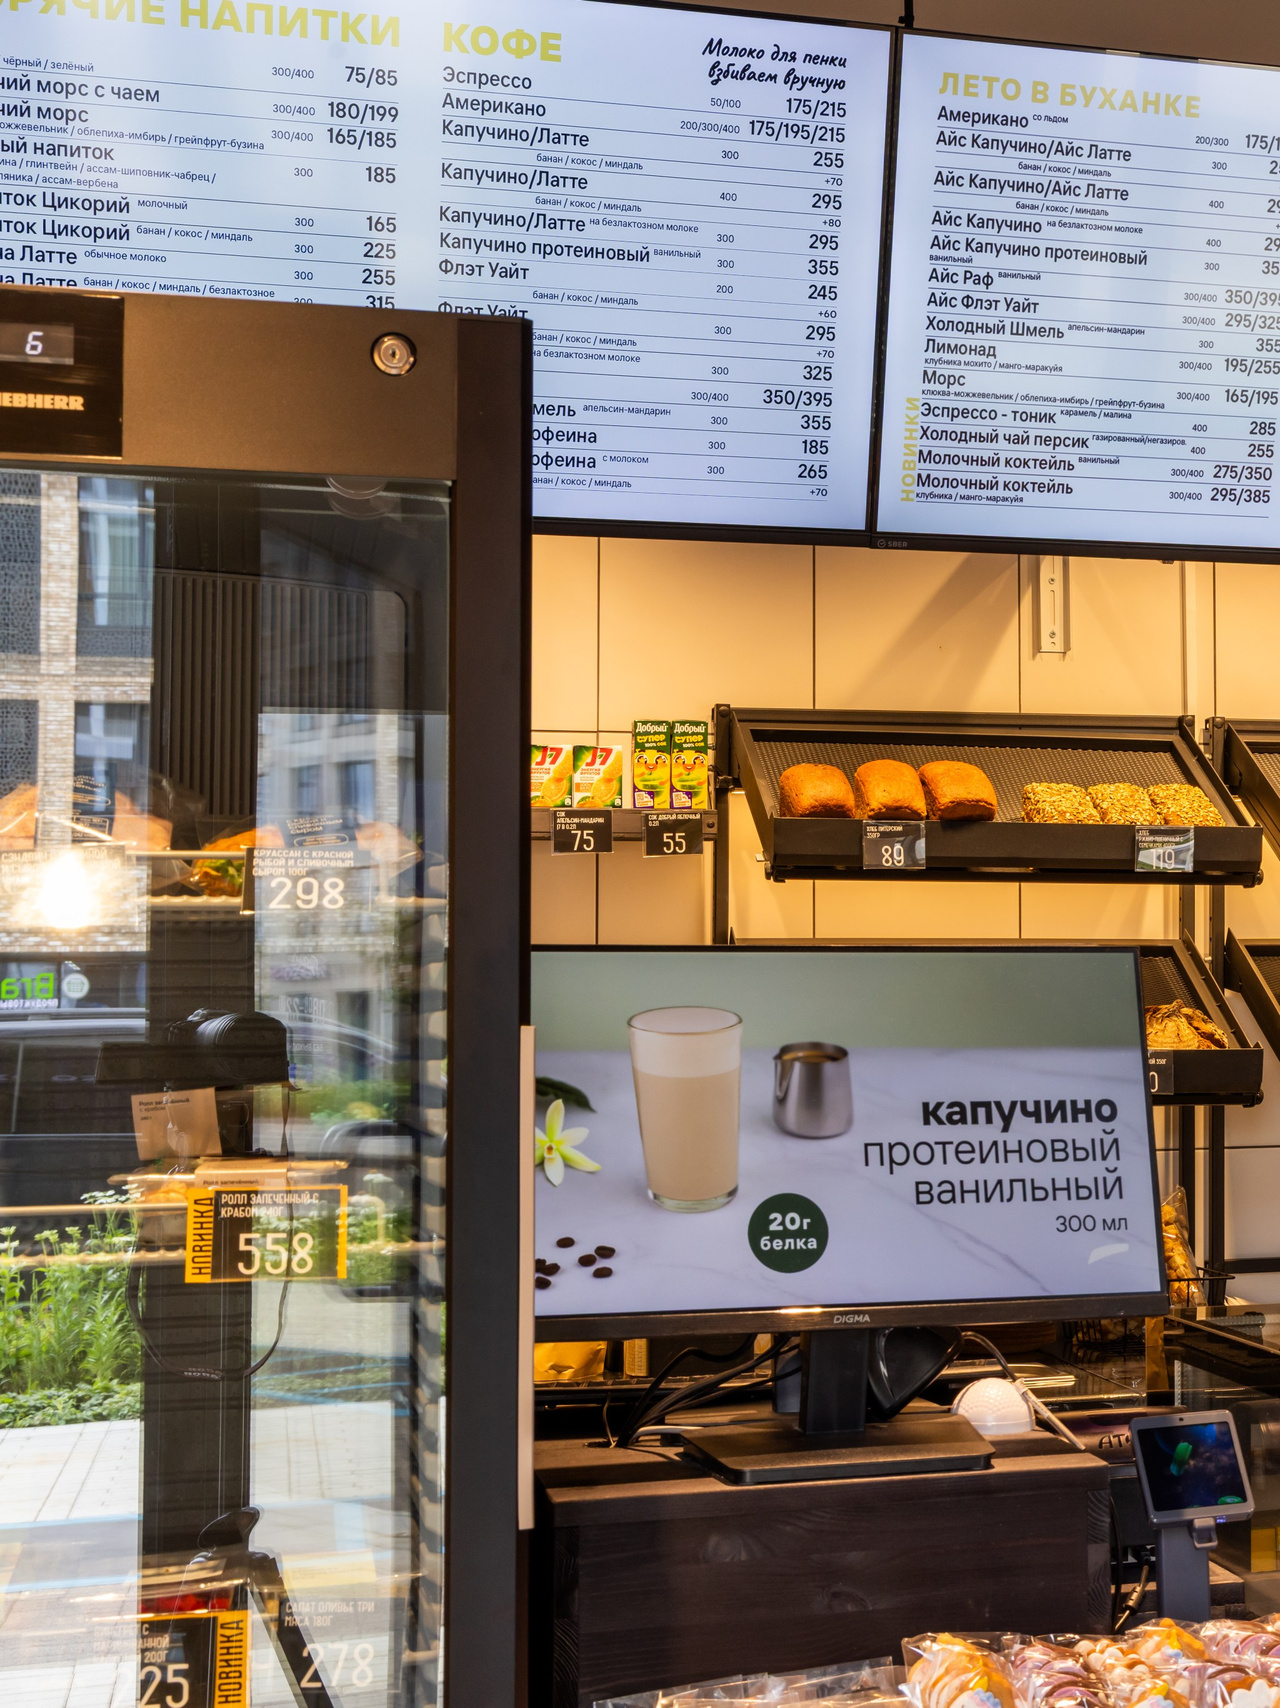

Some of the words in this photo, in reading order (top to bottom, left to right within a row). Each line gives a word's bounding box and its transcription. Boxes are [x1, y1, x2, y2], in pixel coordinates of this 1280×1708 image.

[180, 0, 399, 47] НАПИТКИ
[444, 22, 562, 62] КОФЕ
[701, 37, 765, 60] Молоко
[770, 43, 797, 63] для
[802, 53, 847, 69] пенки
[443, 66, 532, 90] Эспрессо
[710, 97, 742, 110] 50/100
[786, 97, 847, 120] 175/215
[708, 60, 778, 86] взбиваем
[783, 67, 846, 94] вручную
[938, 71, 1021, 101] ЛЕТО
[1031, 80, 1049, 104] В
[1059, 83, 1200, 118] БУХАНКЕ
[441, 92, 546, 119] Американо
[680, 120, 741, 135] 200/300/400
[747, 119, 846, 145] 175/195/215
[937, 105, 1029, 130] Американо
[1032, 113, 1043, 122] со
[1043, 114, 1069, 124] льдом
[1195, 135, 1230, 147] 200/300
[42, 191, 130, 216] Цикорий
[137, 199, 188, 210] молочный
[294, 217, 315, 228] 300
[366, 215, 397, 233] 165
[440, 232, 527, 255] Капучино
[532, 242, 650, 263] протеиновый
[653, 248, 702, 259] ванильный
[716, 259, 735, 269] 300
[807, 258, 839, 276] 355
[25, 331, 44, 355] 6
[0, 391, 84, 411] EBHERR
[900, 397, 920, 502] НОВИНКИ
[918, 449, 1001, 468] Молочный
[1004, 455, 1075, 471] коктейль
[1078, 456, 1120, 465] ванильный
[1170, 468, 1205, 479] 300/400
[1212, 464, 1273, 483] 275/350
[887, 540, 908, 548] SBER
[636, 723, 668, 733] Добрый
[674, 723, 706, 733] Добрый
[535, 747, 563, 766] J7
[585, 747, 613, 767] J7
[254, 849, 300, 857] КРУАССАН
[312, 850, 354, 858] КРАСНОЙ
[571, 830, 594, 850] 75
[663, 833, 686, 853] 55
[882, 845, 904, 866] 89
[252, 867, 285, 876] СЫРОМ
[288, 868, 308, 876] 100Г
[253, 857, 285, 866] РЫБОЙ
[288, 858, 294, 866] И
[297, 859, 354, 867] СЛИВОЧНЫМ
[1150, 849, 1175, 869] 119
[269, 877, 345, 909] 298
[922, 1098, 1118, 1135] капучино
[864, 1128, 1120, 1175] протеиновый
[222, 1194, 248, 1204] РОЛЛ
[250, 1192, 310, 1204] ЗАПЕЧЕННЫЙ
[313, 1193, 319, 1203] С
[915, 1166, 1123, 1205] ванильный
[191, 1197, 214, 1276] НОВИНКА
[768, 1212, 811, 1231] 20г
[1055, 1214, 1097, 1233] 300
[1102, 1217, 1128, 1231] мл
[238, 1233, 314, 1275] 558
[760, 1235, 818, 1251] белка
[833, 1314, 871, 1324] DIGMA
[217, 1619, 244, 1705] НОВИНКА
[300, 1642, 374, 1688] 278
